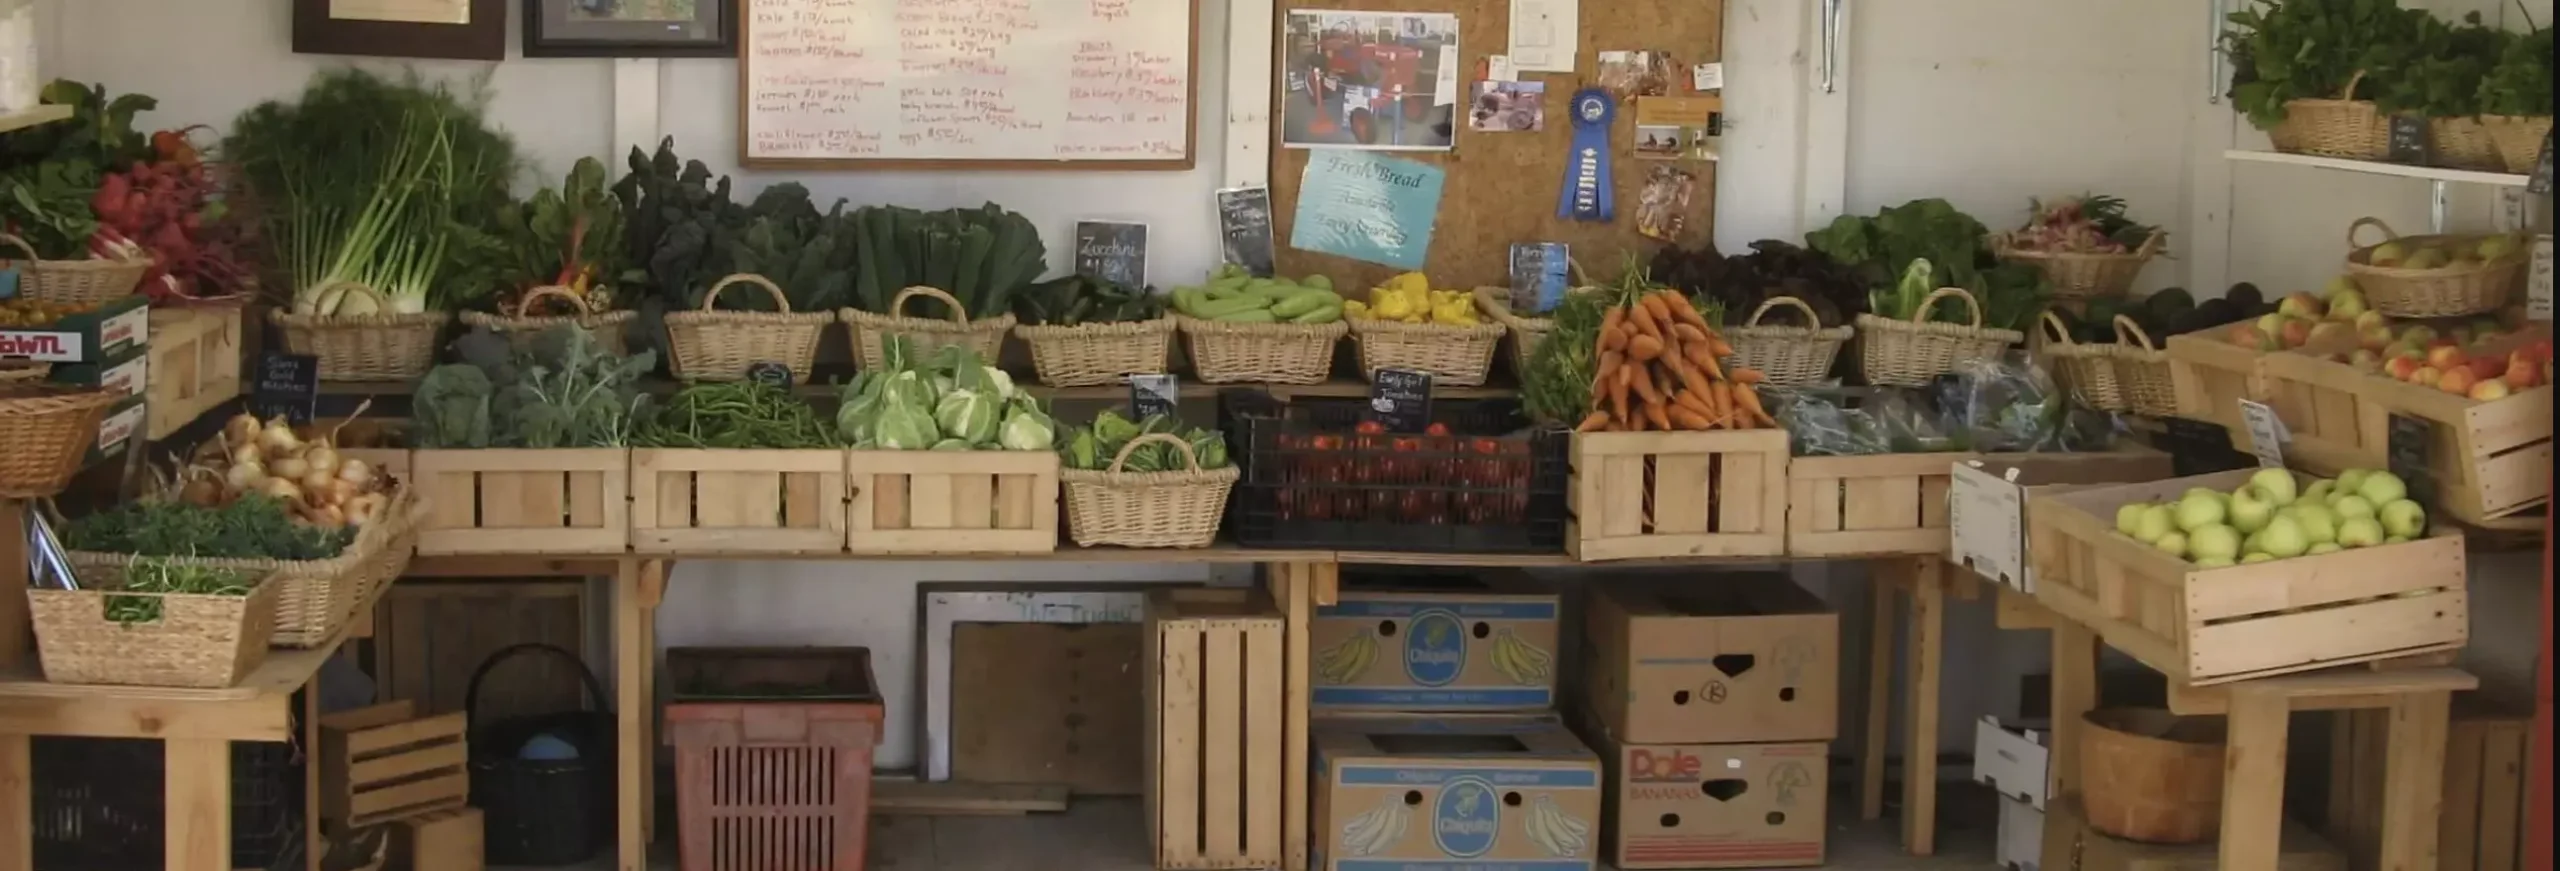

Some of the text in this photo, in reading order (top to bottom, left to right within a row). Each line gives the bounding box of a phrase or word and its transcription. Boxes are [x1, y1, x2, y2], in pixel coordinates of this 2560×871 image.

[1326, 156, 1426, 188] Fresh Bread
[1410, 648, 1459, 667] Chiquita
[1629, 748, 1702, 779] Dole
[1629, 786, 1701, 800] BANANAS
[1439, 817, 1493, 836] Chiquita
